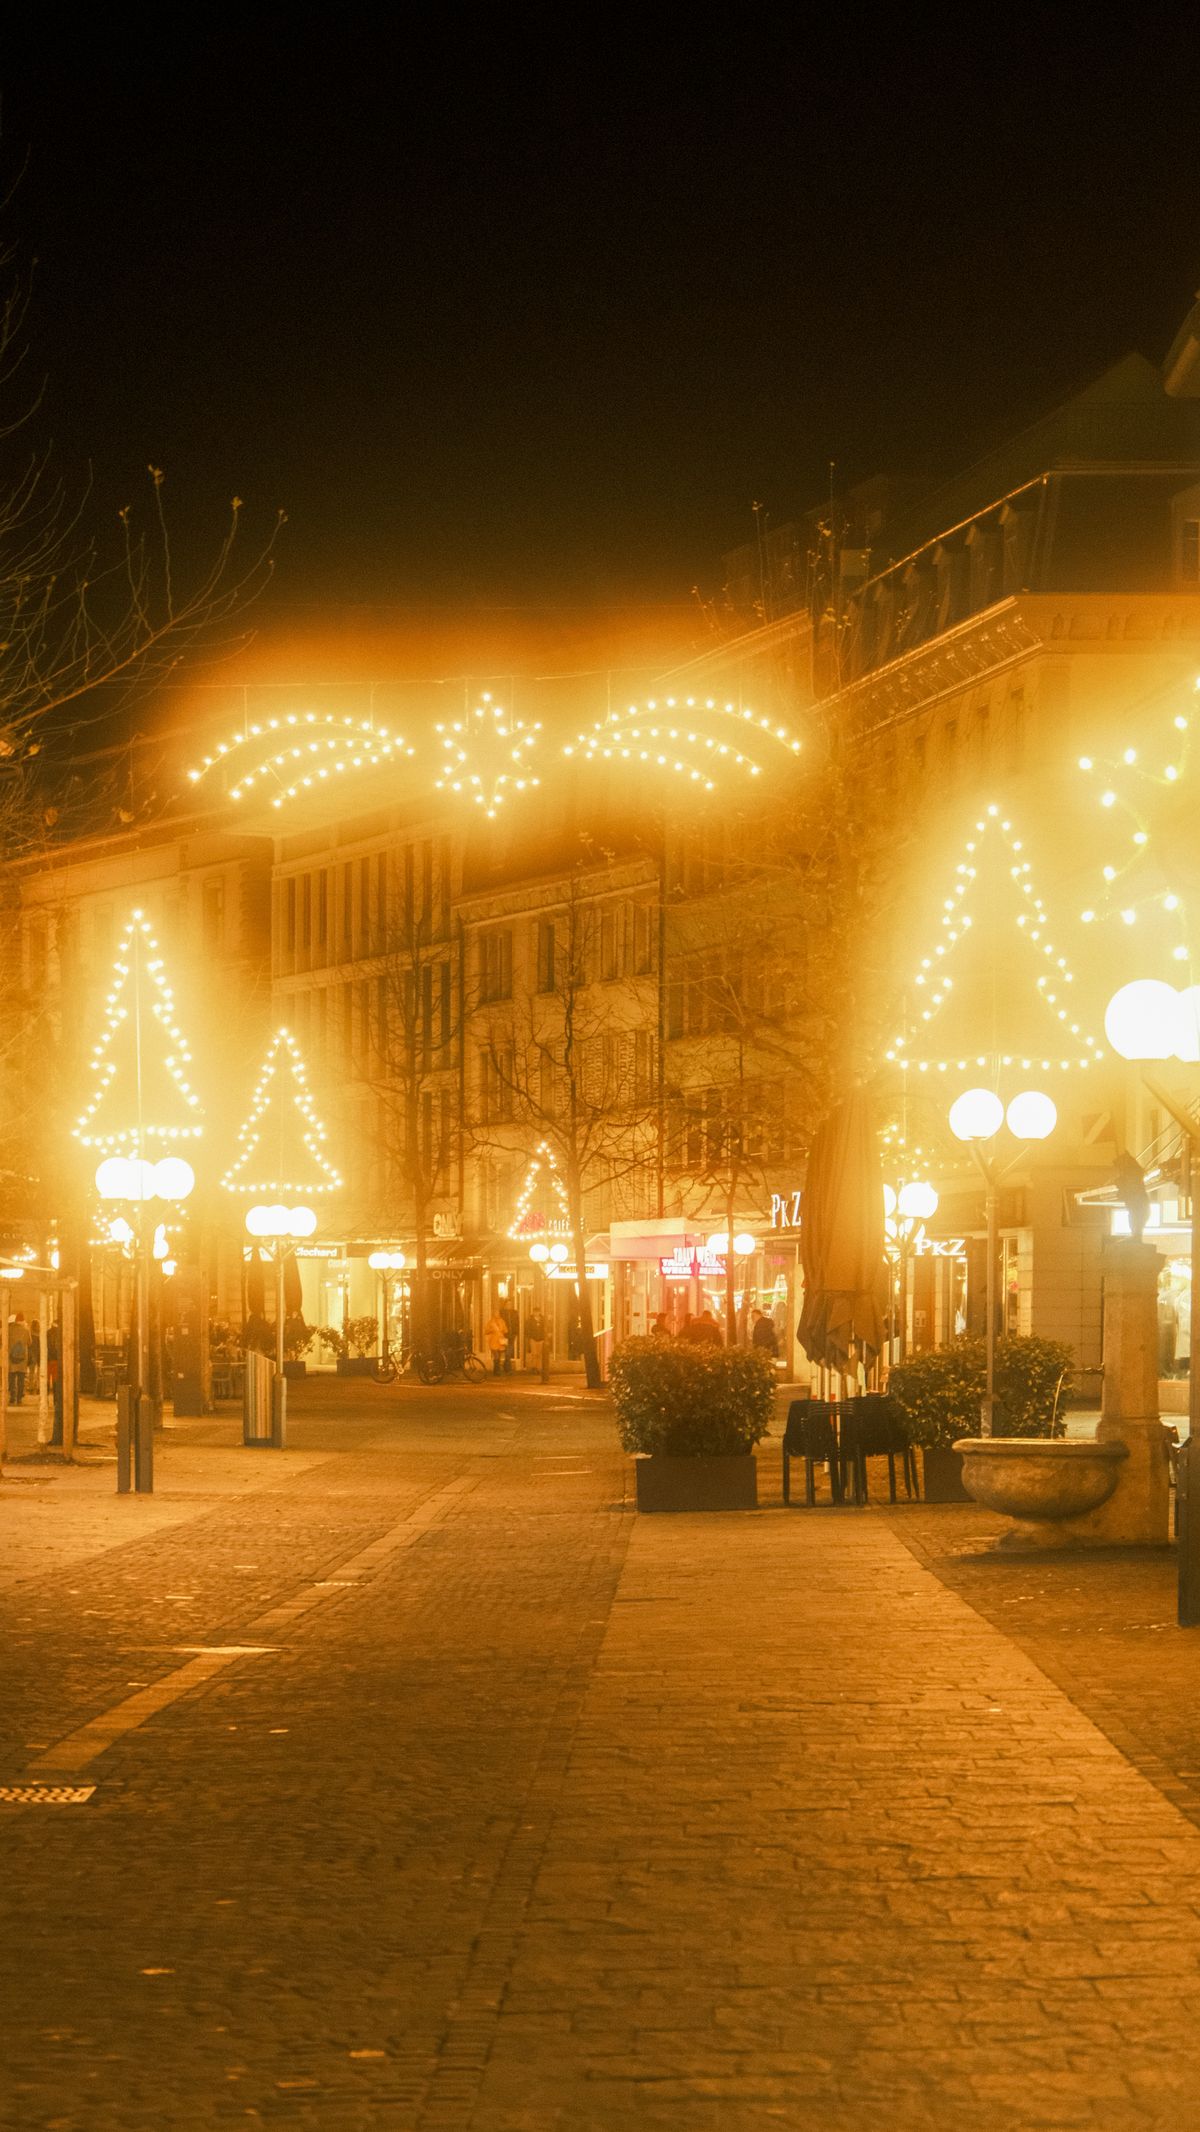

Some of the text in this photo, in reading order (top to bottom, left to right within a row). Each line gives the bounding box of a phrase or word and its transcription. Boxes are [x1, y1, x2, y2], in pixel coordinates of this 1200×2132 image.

[771, 1191, 801, 1228] PKZ
[914, 1239, 966, 1256] PKZ
[432, 1270, 465, 1280] ONLY
